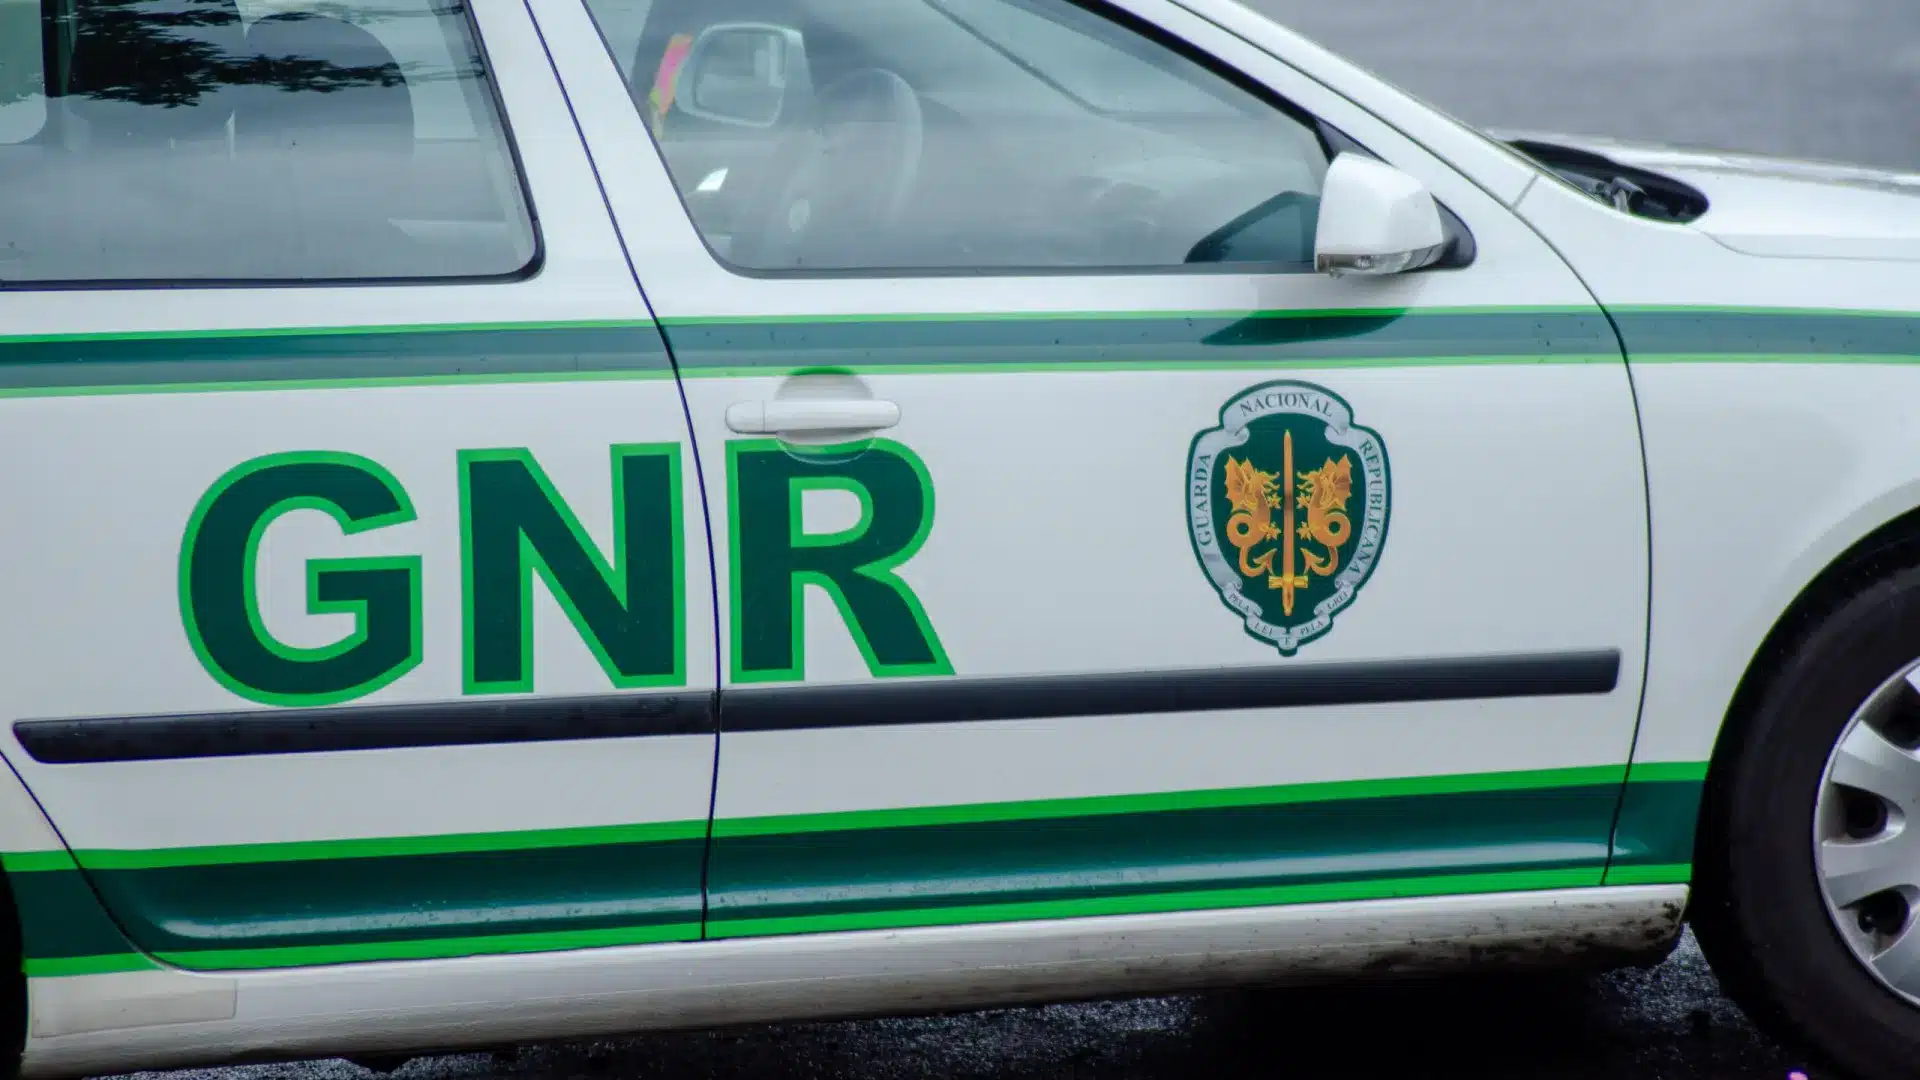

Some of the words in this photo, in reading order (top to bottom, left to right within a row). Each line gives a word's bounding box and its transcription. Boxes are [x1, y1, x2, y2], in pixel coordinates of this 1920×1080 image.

[1239, 392, 1333, 418] NACIONAL
[1193, 453, 1212, 546] GUARDA
[1348, 438, 1386, 575] REPUBLICANA
[177, 436, 957, 708] GNR
